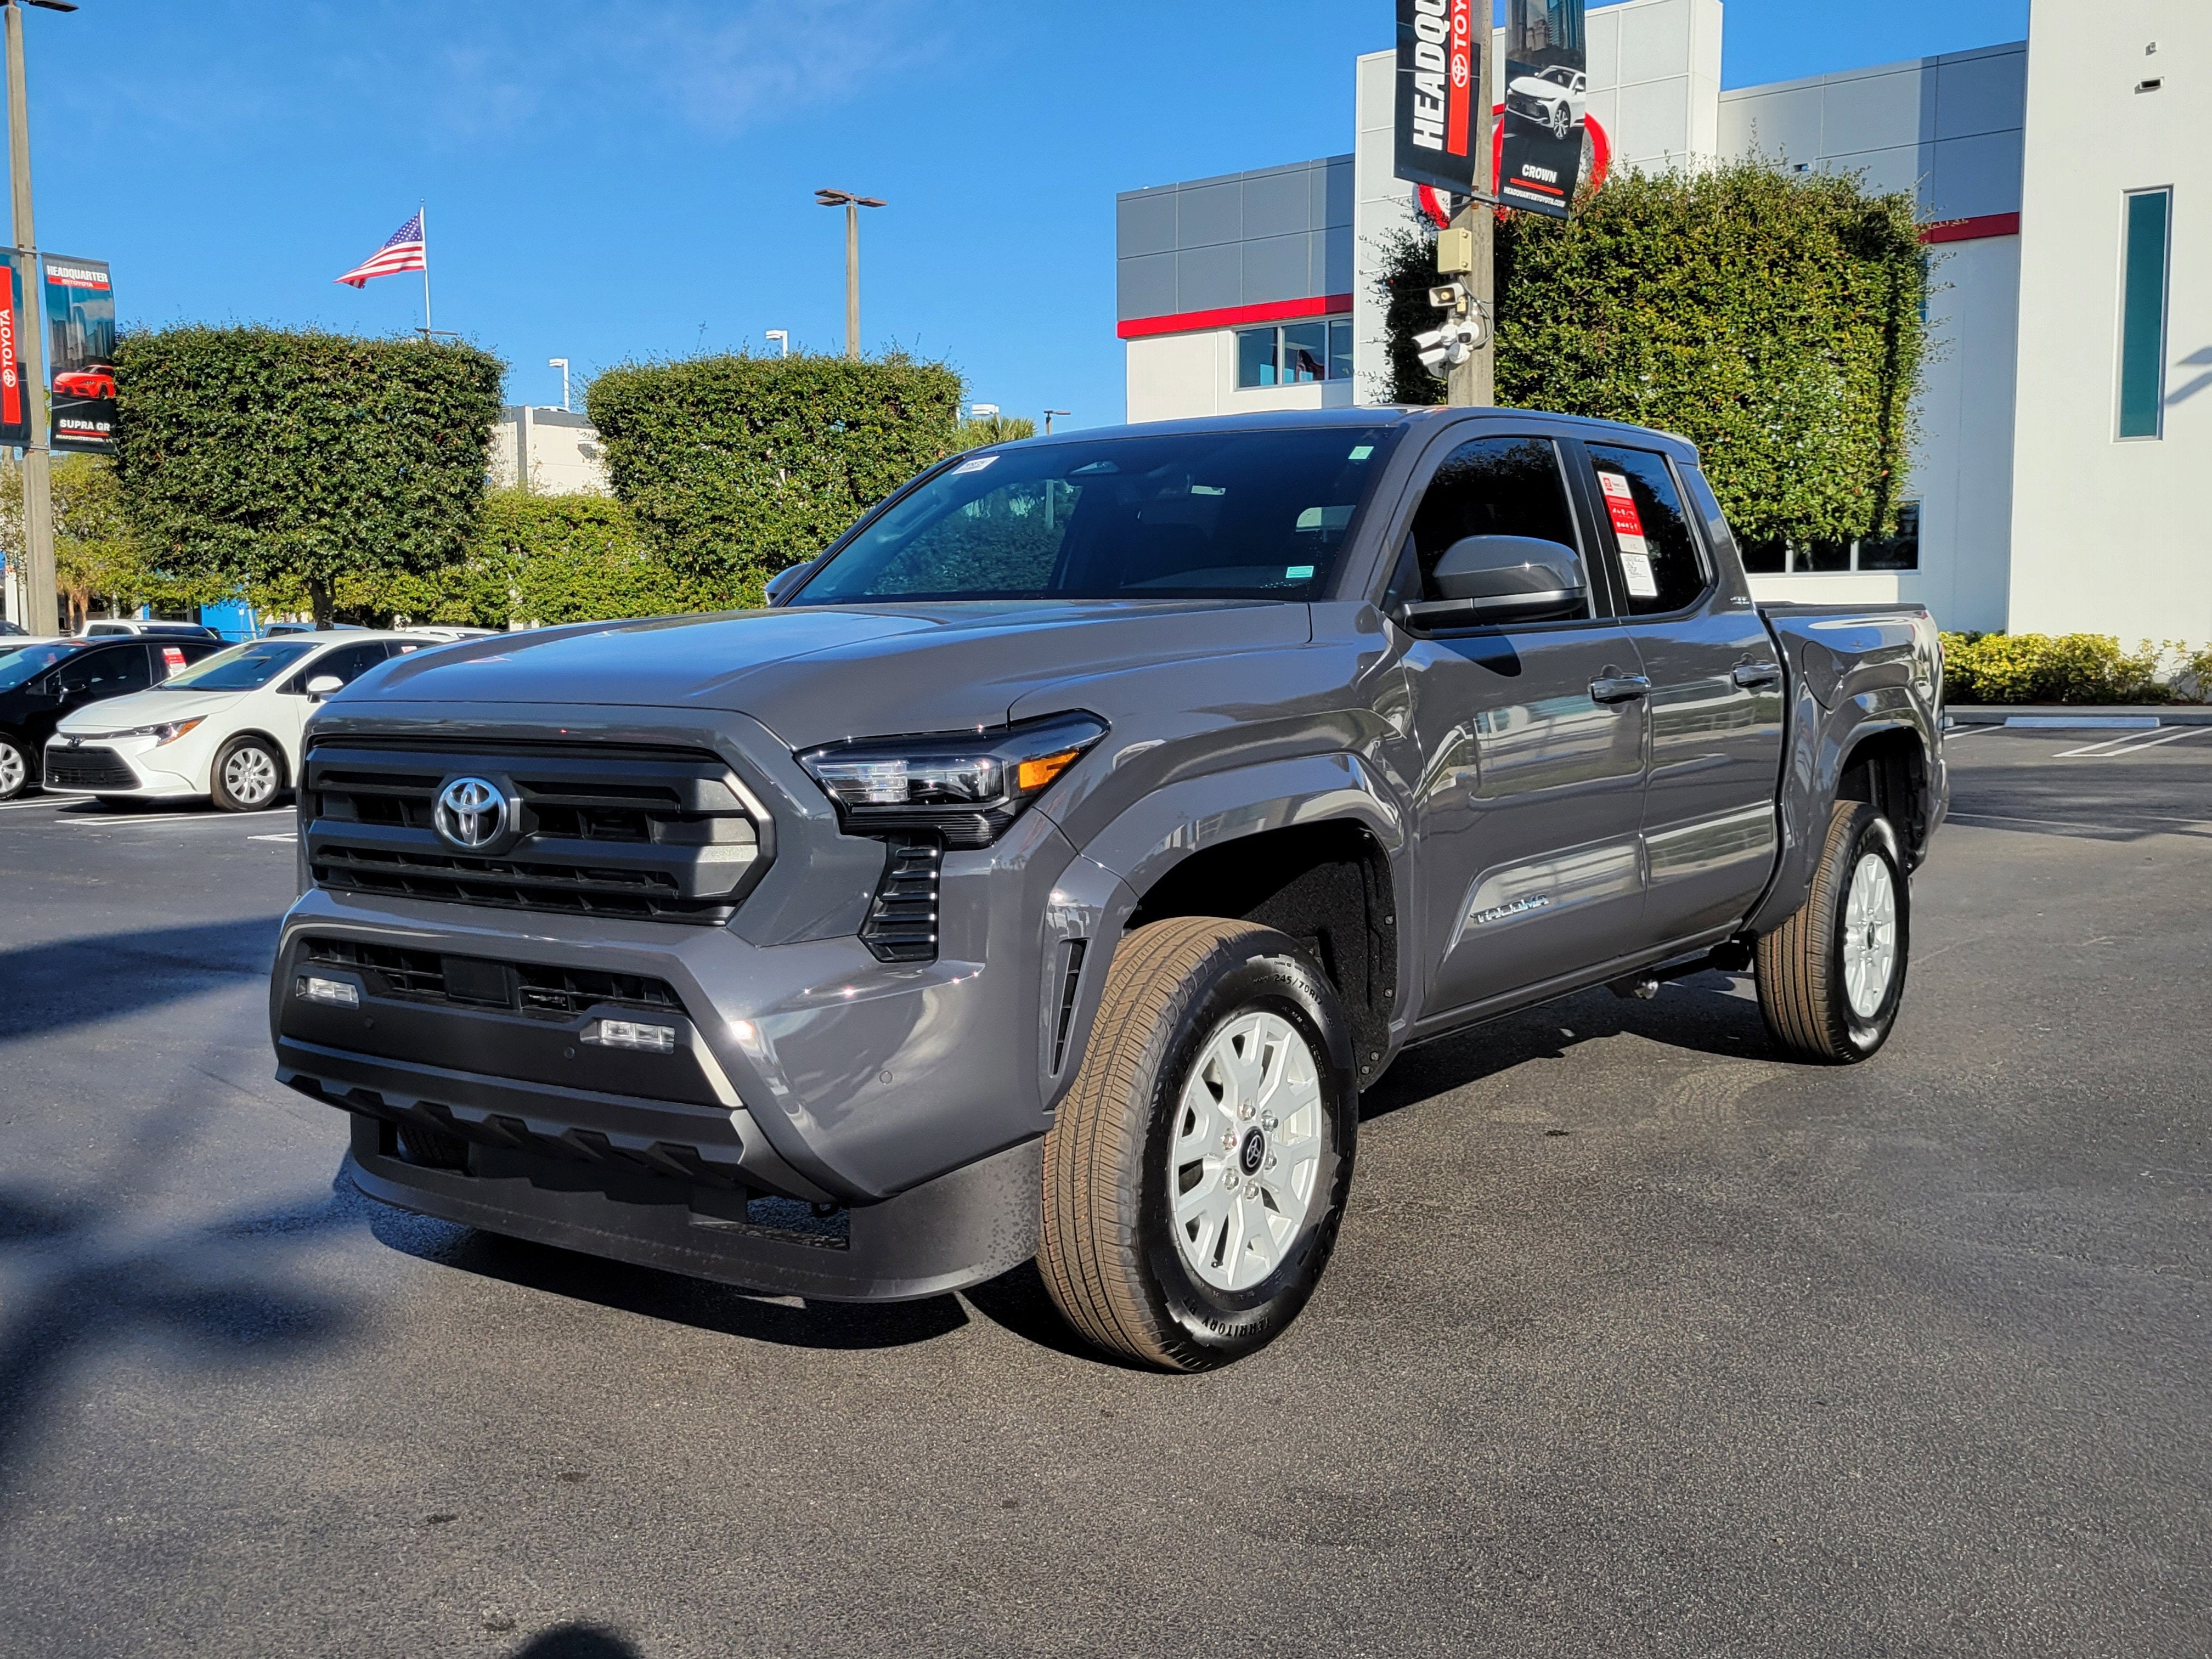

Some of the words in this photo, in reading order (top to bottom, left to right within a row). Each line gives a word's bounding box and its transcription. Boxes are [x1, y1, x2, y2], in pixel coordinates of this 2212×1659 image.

[1522, 164, 1558, 183] CROWN
[47, 265, 108, 283] HEADQUARTER
[0, 309, 13, 367] TOYOTA
[60, 419, 94, 430] SUPRA
[96, 422, 110, 432] GR
[1274, 974, 1323, 1006] 245/70R17
[1202, 1316, 1271, 1338] TERRITORY
